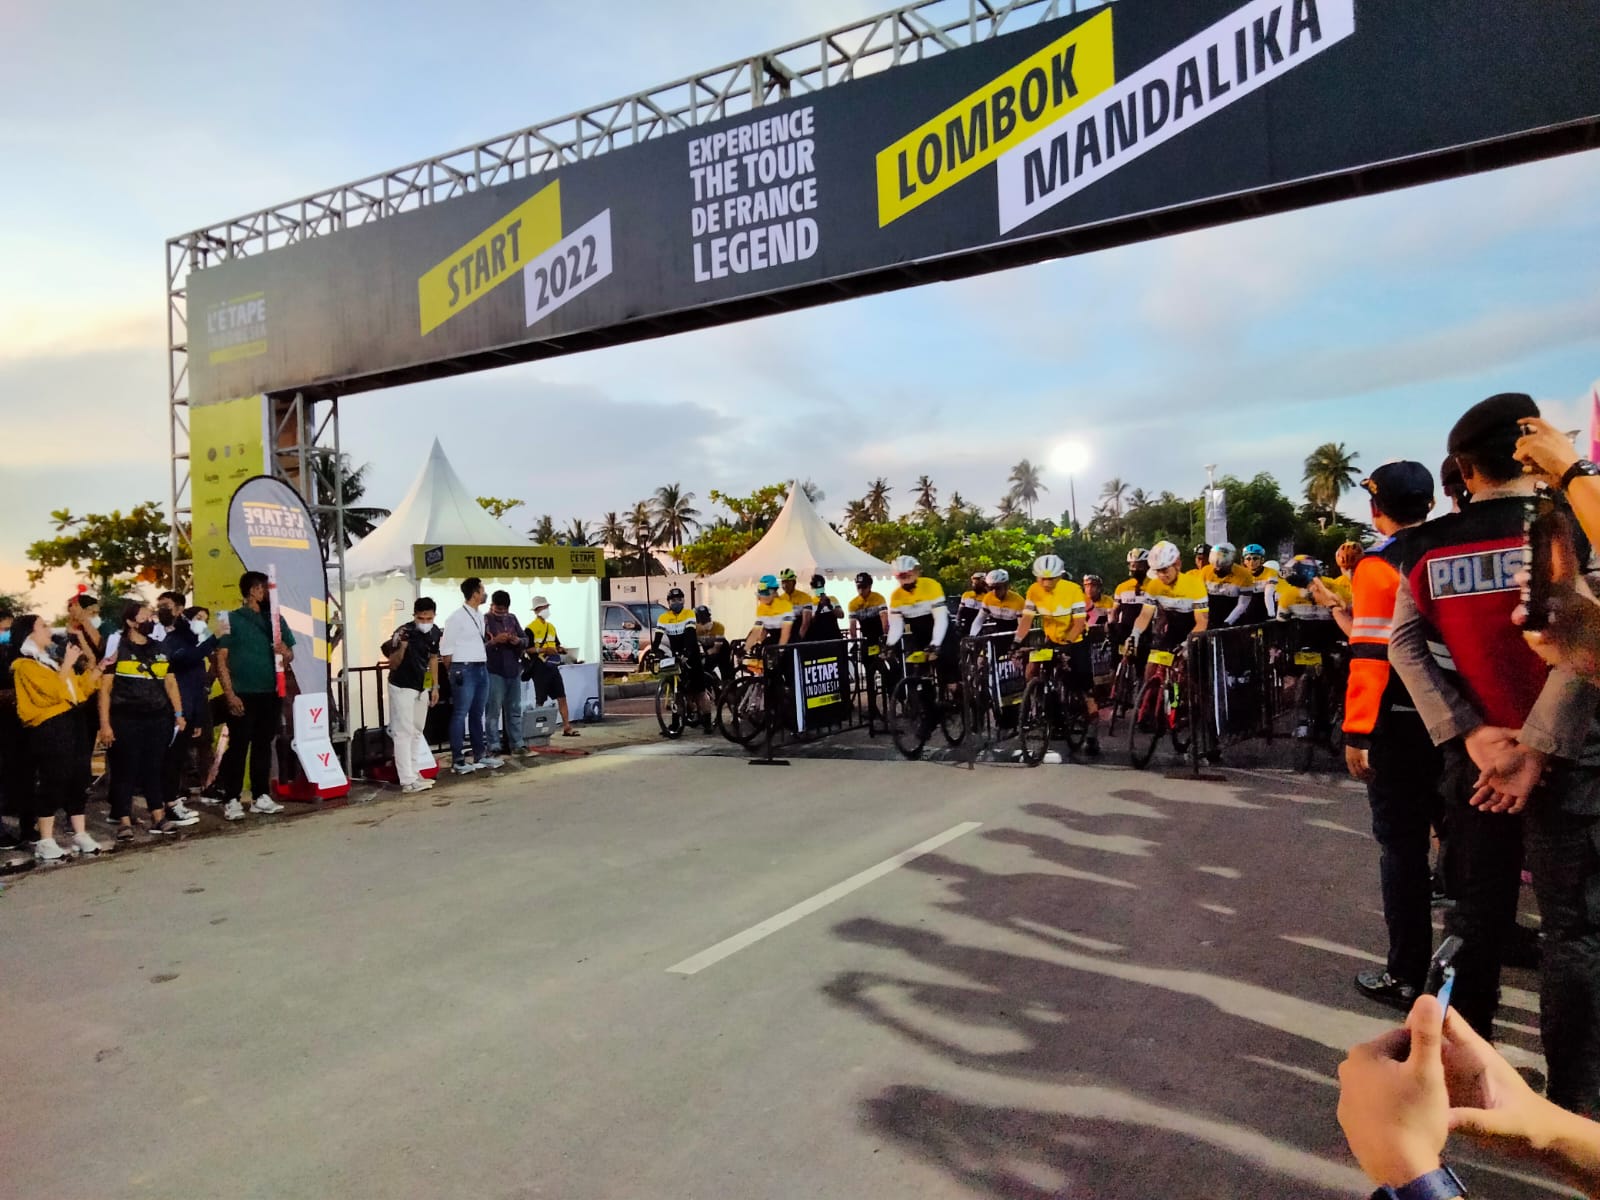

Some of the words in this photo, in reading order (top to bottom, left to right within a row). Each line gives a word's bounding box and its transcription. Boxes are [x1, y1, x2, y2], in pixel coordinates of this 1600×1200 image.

[897, 44, 1079, 202] LOMBOK
[1023, 0, 1323, 206] MANDALIKA
[688, 106, 815, 167] EXPERIENCE
[690, 158, 738, 201] THE
[743, 138, 815, 188] TOUR
[691, 202, 720, 237] DE
[724, 177, 818, 229] FRANCE
[447, 219, 522, 308] START
[535, 235, 598, 311] 2022
[693, 217, 819, 283] LEGEND
[466, 556, 509, 570] TIMING
[512, 556, 555, 570] SYSTEM
